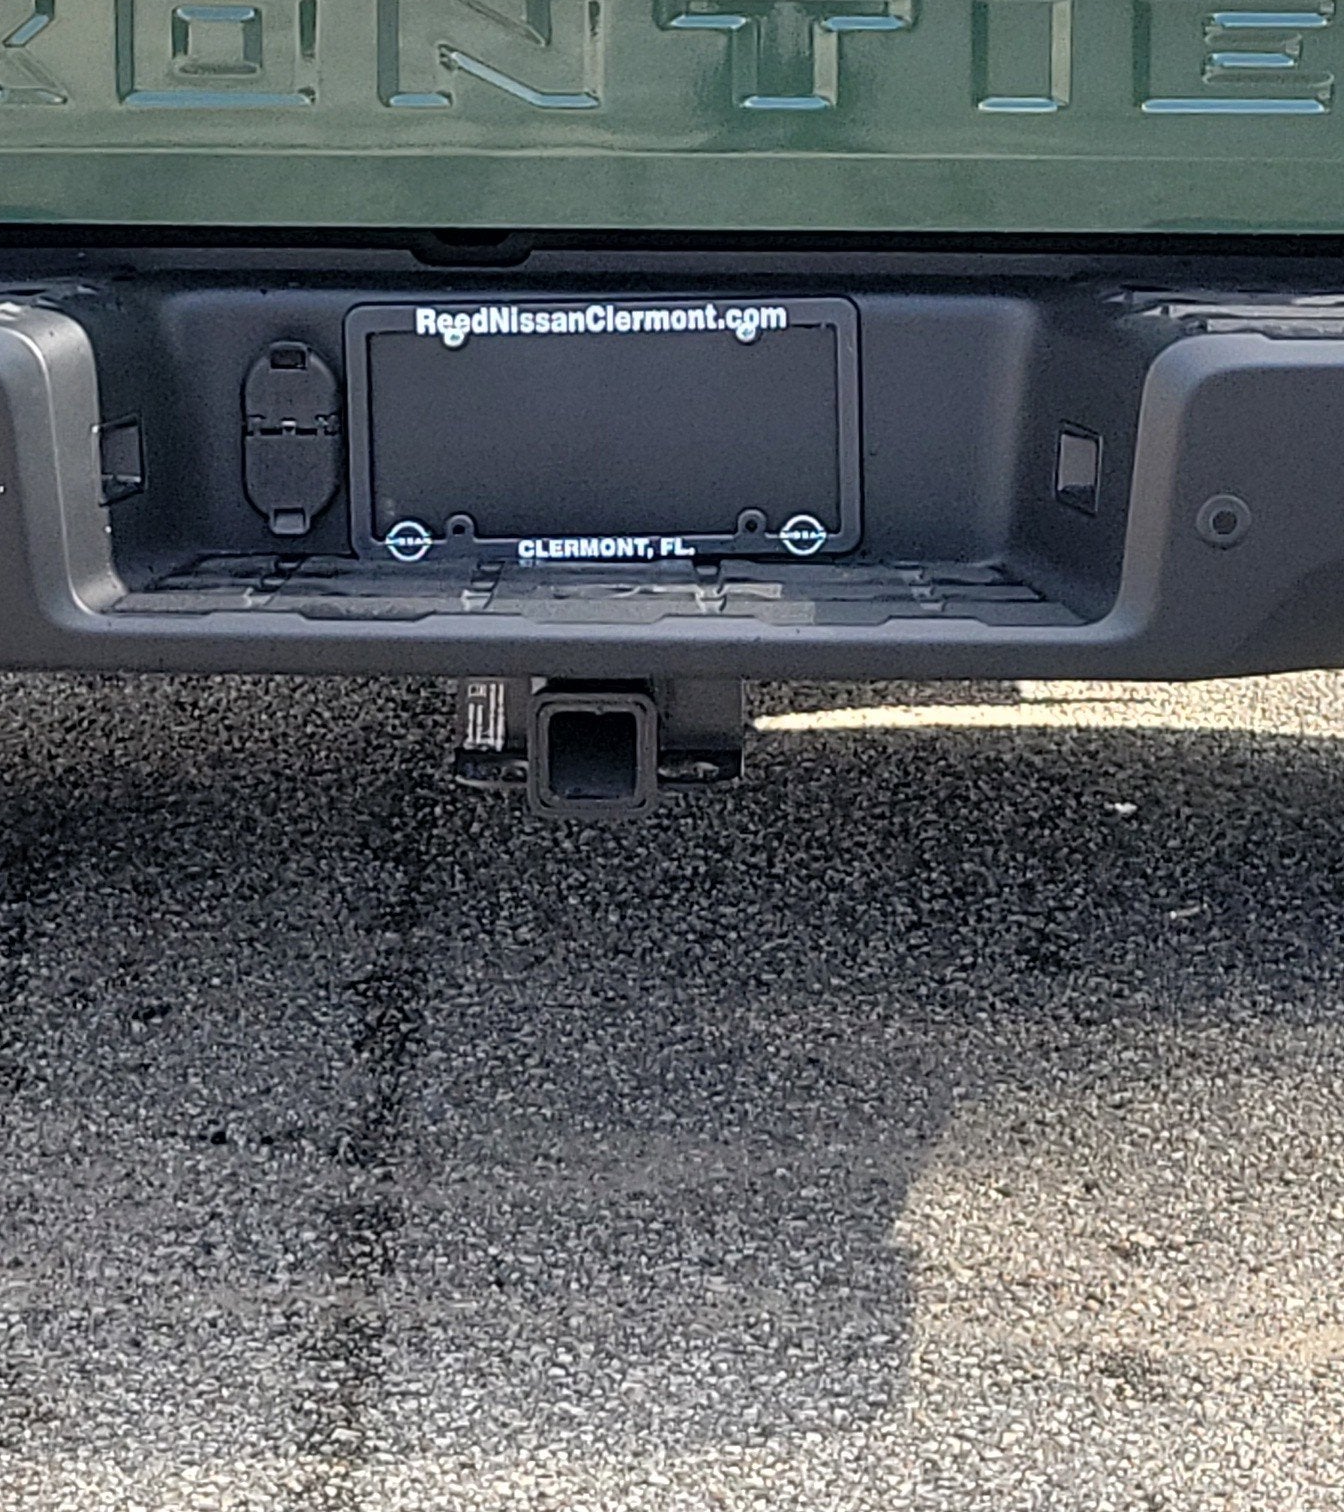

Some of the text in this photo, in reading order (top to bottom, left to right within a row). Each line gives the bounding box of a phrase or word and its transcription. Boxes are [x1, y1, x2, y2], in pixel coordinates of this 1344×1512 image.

[415, 303, 788, 336] ReedNissanClermont.com
[518, 537, 696, 560] CLERMONT, FL.
